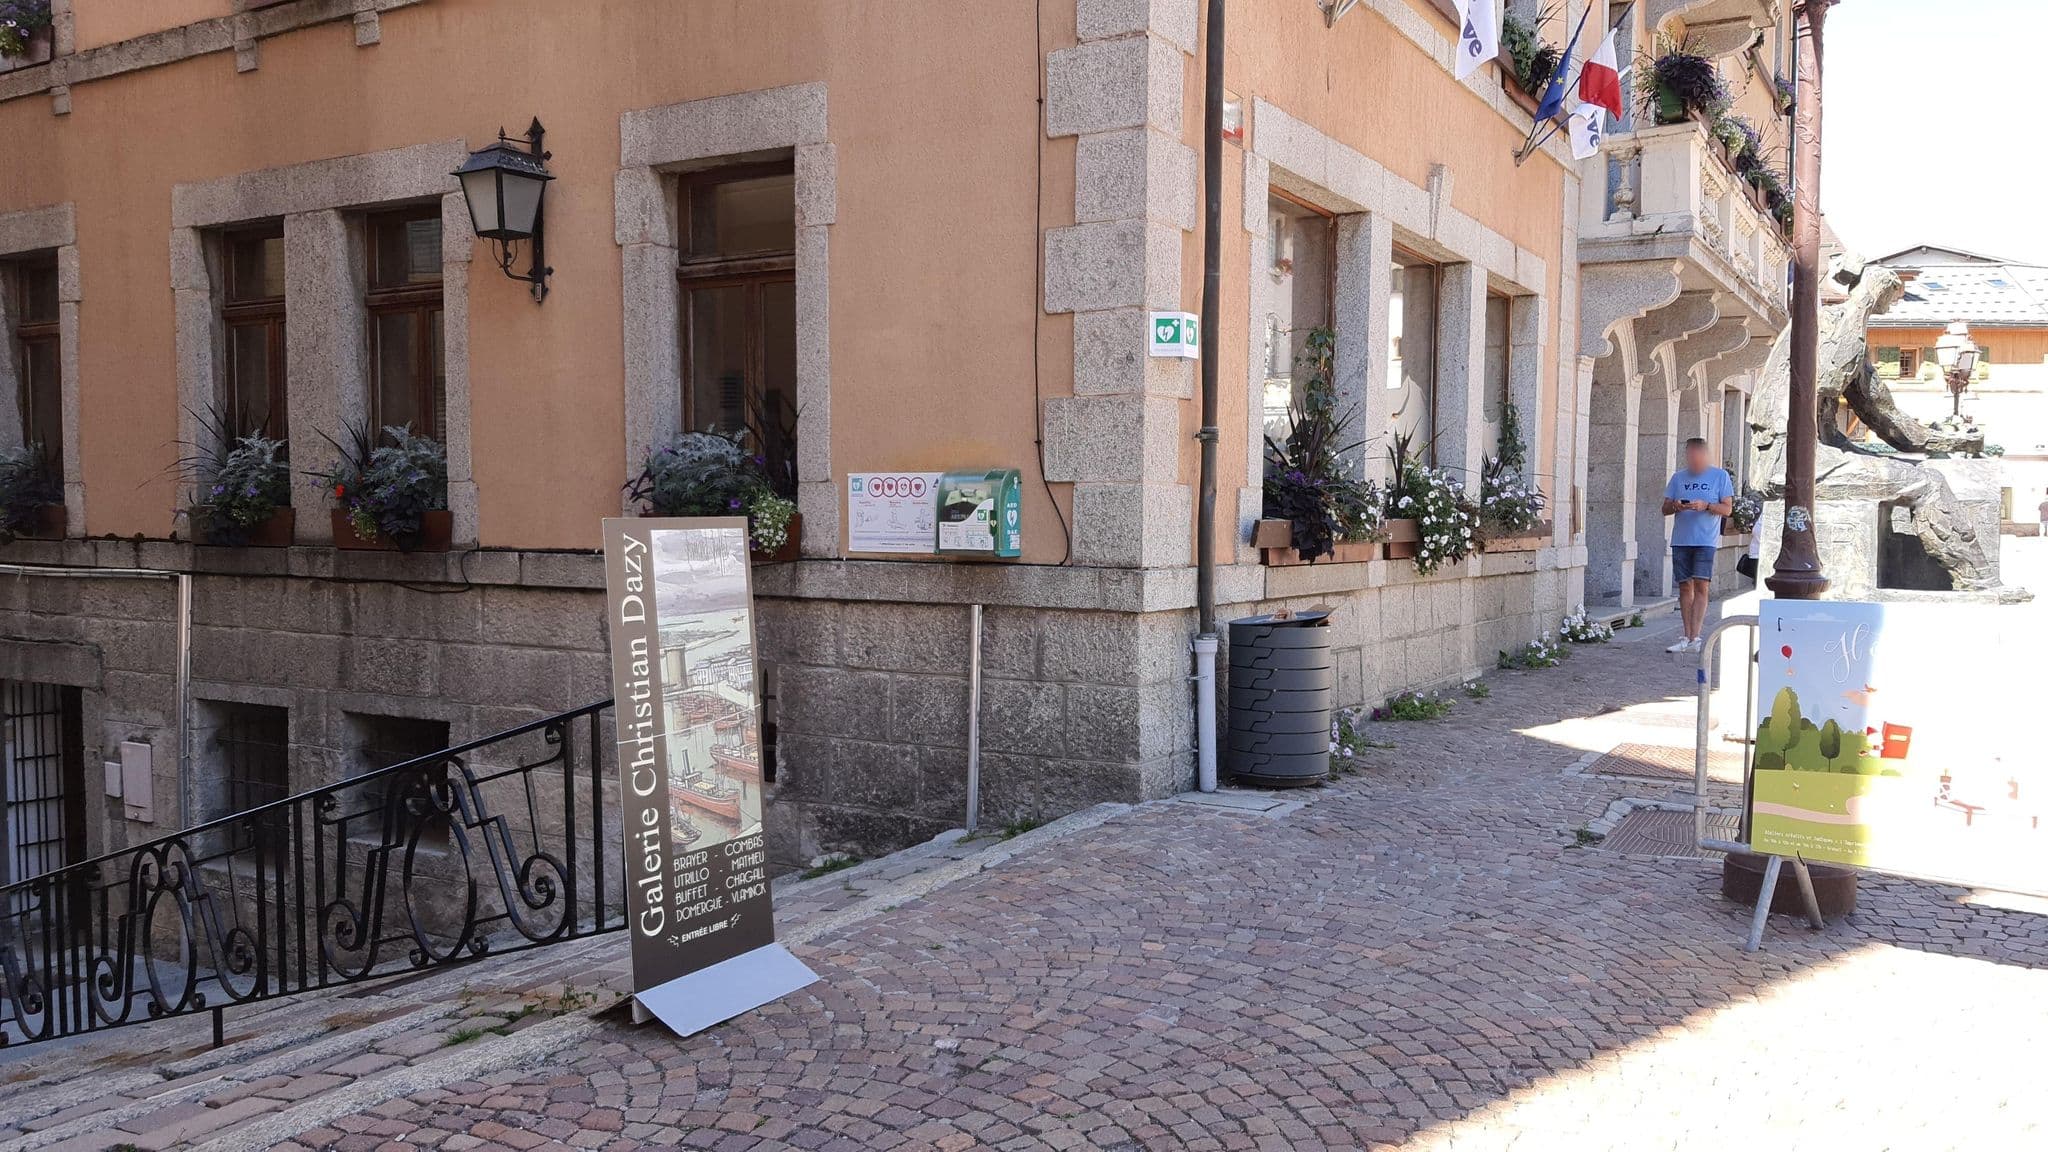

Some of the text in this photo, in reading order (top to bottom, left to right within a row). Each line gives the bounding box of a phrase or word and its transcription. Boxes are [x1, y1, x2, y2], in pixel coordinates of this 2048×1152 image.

[621, 532, 665, 937] Galerie Christian Dazy
[673, 851, 708, 872] BRAYER
[724, 835, 764, 856] COMBAS
[674, 867, 710, 888] UTRILLO
[731, 850, 765, 871] MATHIEU
[675, 884, 708, 905] BUFFET
[725, 867, 765, 889] CHAGALL
[676, 896, 723, 922] DOMERGUE
[681, 920, 728, 943] ENTRÉE LIBRE
